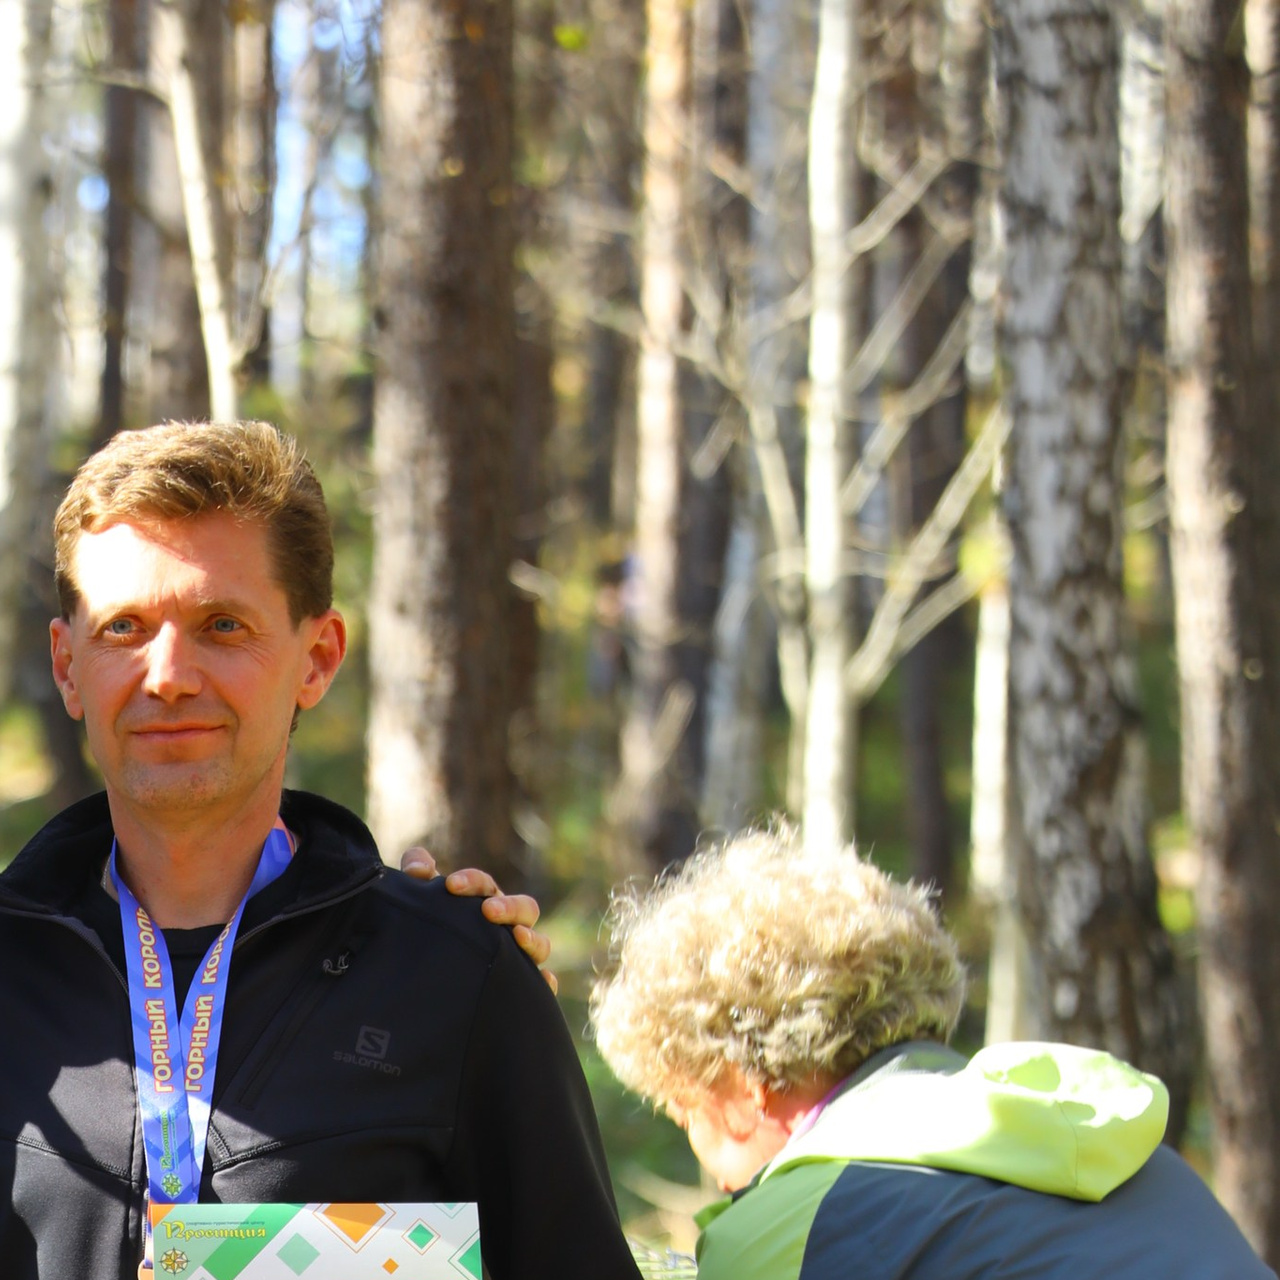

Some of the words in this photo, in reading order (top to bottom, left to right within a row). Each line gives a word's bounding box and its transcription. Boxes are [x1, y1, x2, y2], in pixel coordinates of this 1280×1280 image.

[145, 998, 174, 1093] ГОРНЫЙ
[184, 994, 214, 1092] ГОРНЫЙ
[202, 910, 238, 985] КОРО
[332, 1051, 402, 1077] salomon
